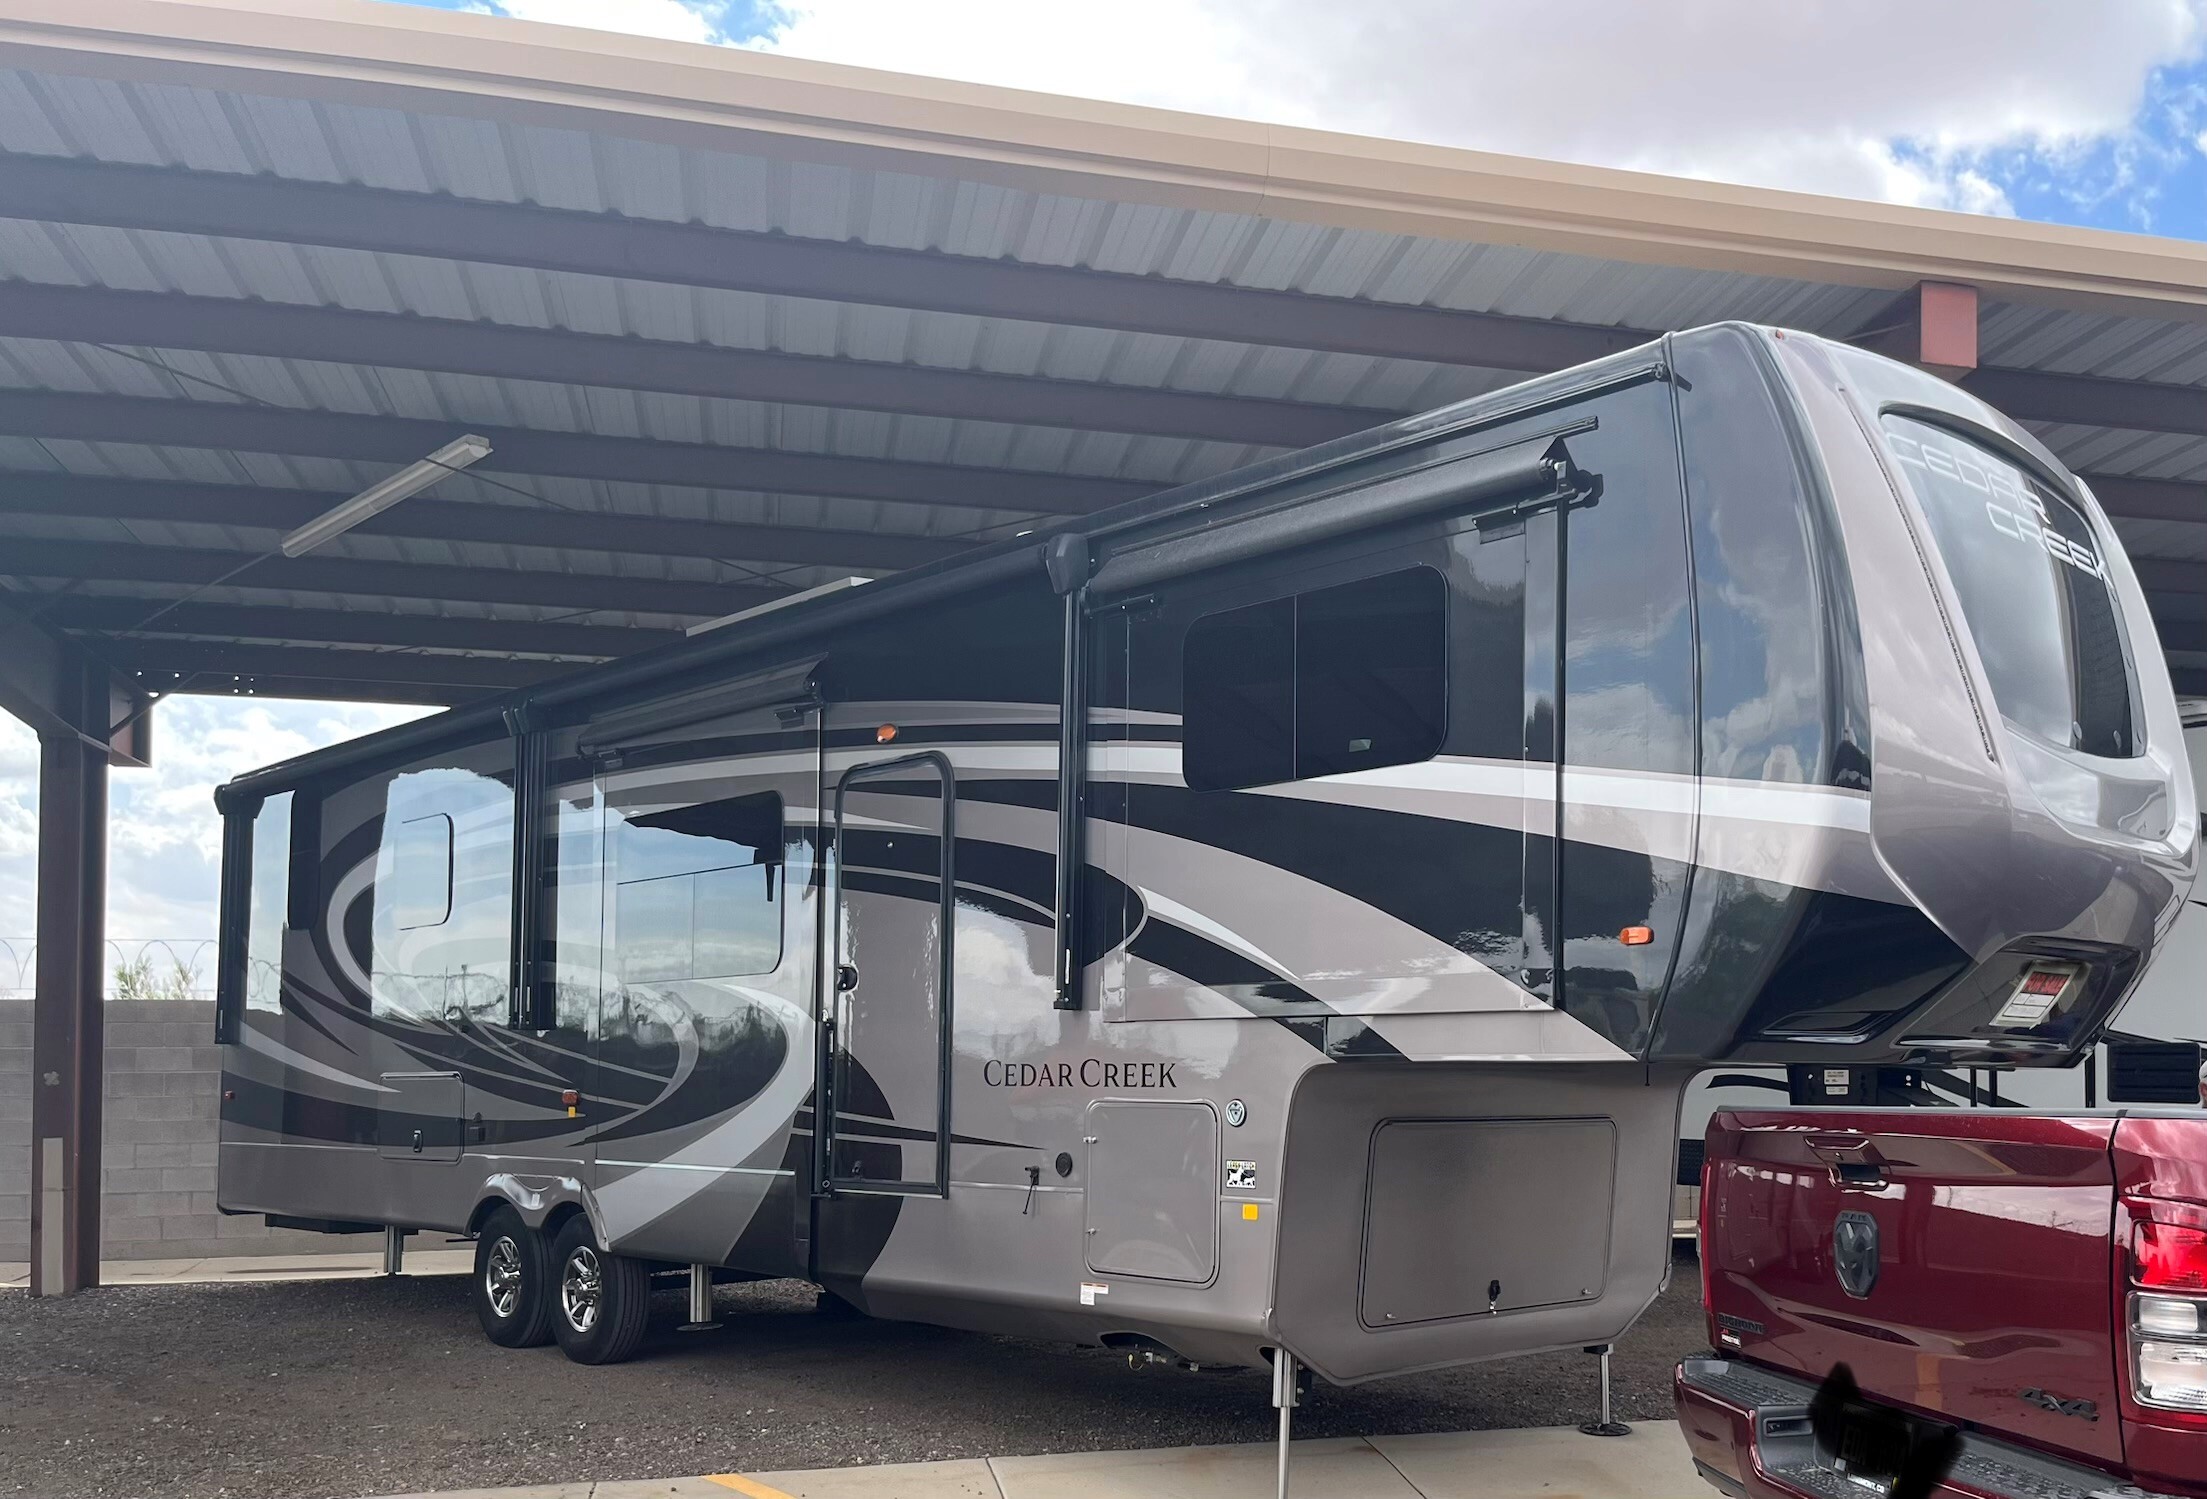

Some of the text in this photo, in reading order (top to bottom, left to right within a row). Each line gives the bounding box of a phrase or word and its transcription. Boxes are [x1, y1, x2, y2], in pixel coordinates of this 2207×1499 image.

[1887, 433, 2051, 525] CEDAR
[1986, 501, 2114, 591] CREEK
[983, 1058, 1177, 1088] CEDAR CREEK
